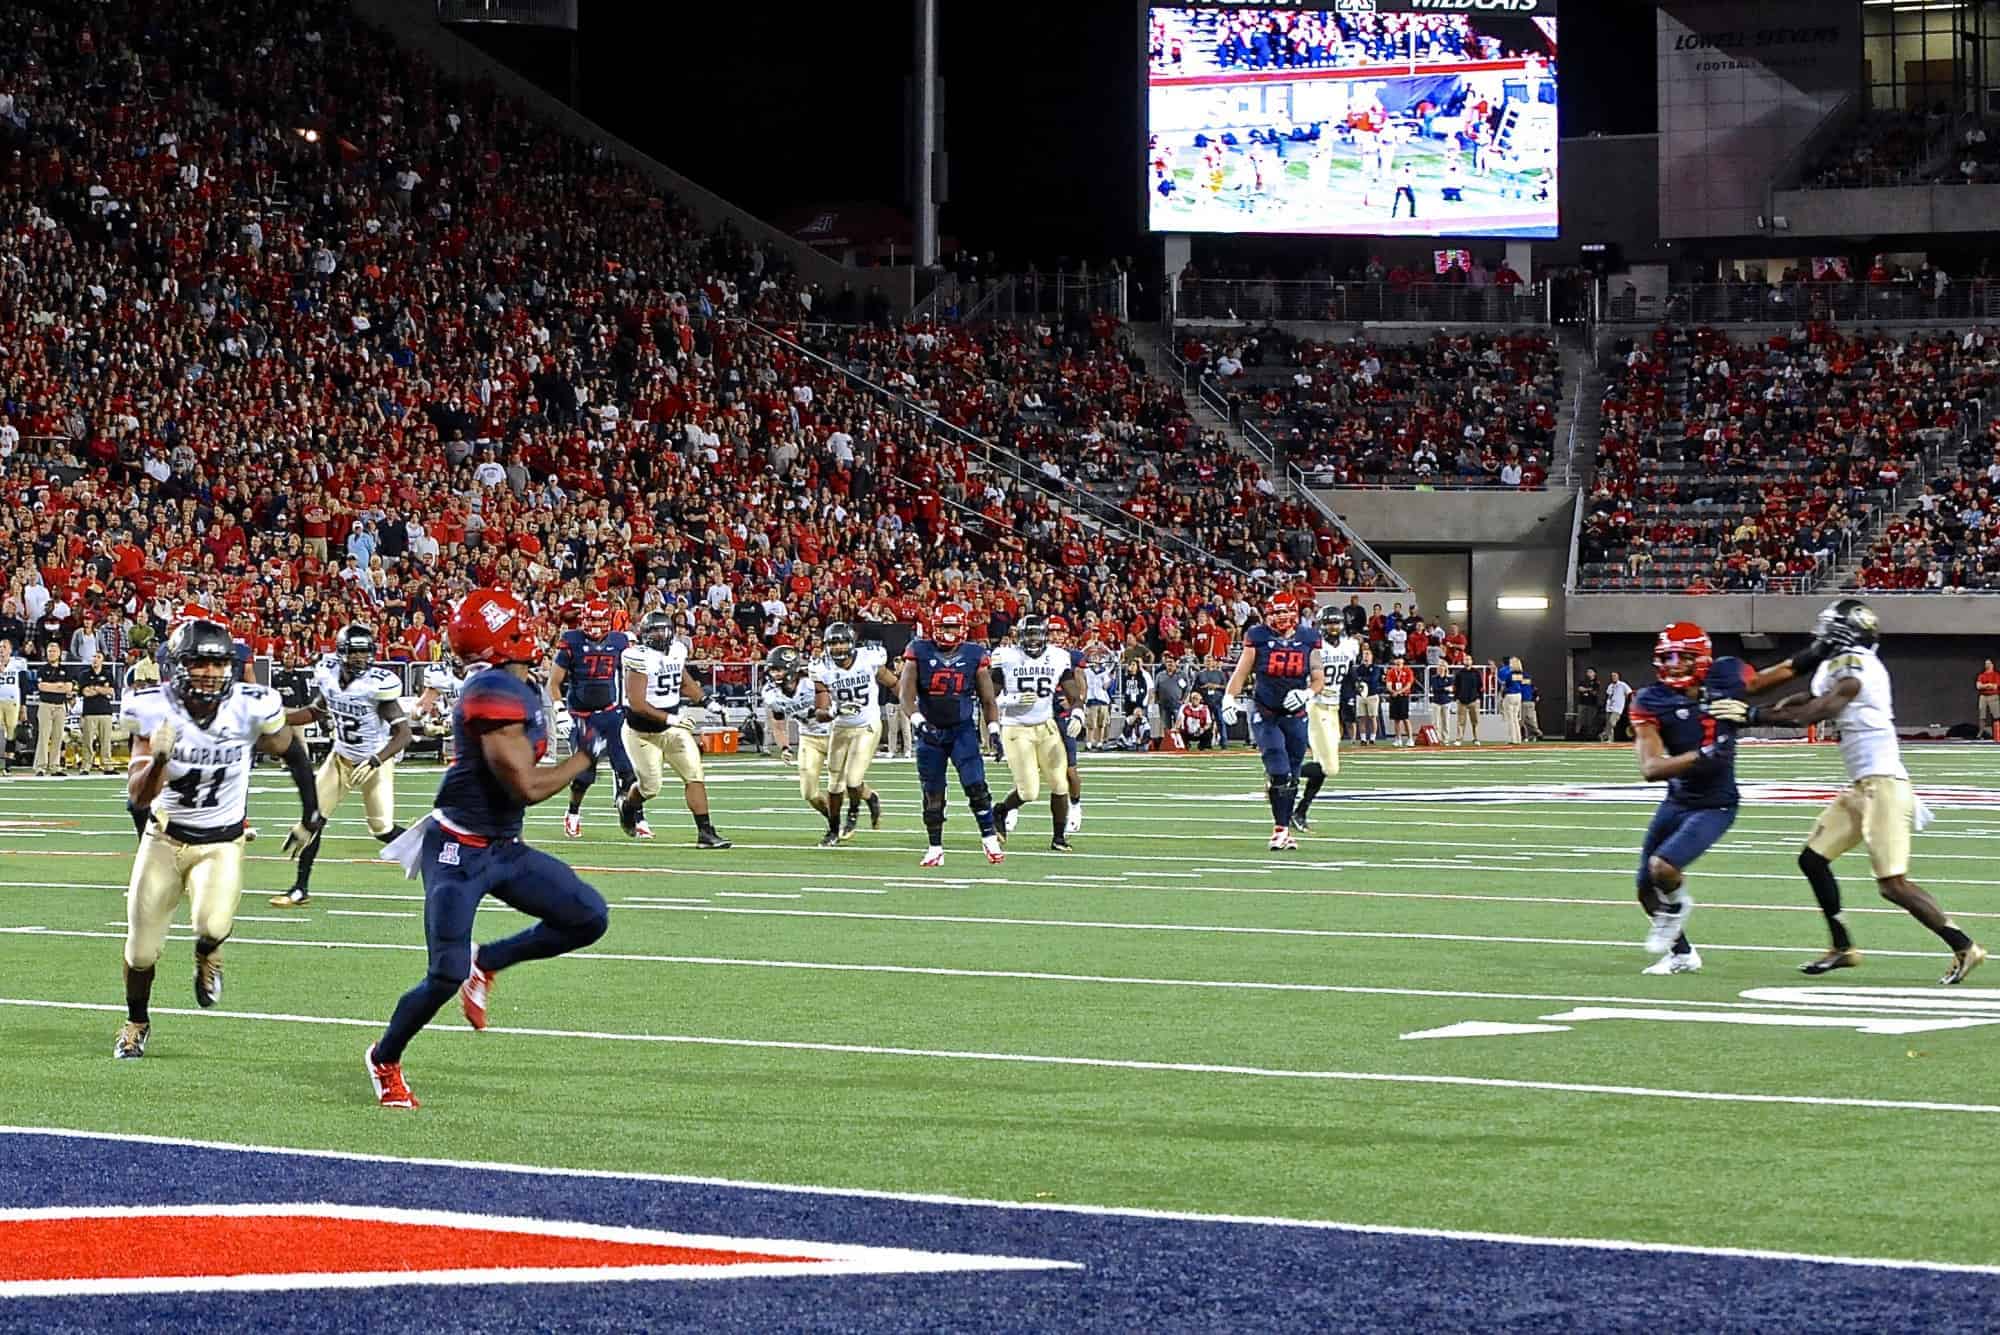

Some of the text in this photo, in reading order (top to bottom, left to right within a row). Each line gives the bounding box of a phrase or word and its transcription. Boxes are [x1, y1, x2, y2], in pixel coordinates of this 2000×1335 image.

[583, 655, 614, 679] 73
[1013, 666, 1056, 677] COLORADO
[1267, 651, 1304, 678] 68
[655, 673, 681, 696] 55
[832, 674, 871, 689] COLORADO
[1017, 677, 1052, 698] 56
[334, 712, 364, 744] 12
[170, 745, 243, 766] OLORADO
[168, 767, 227, 808] 41
